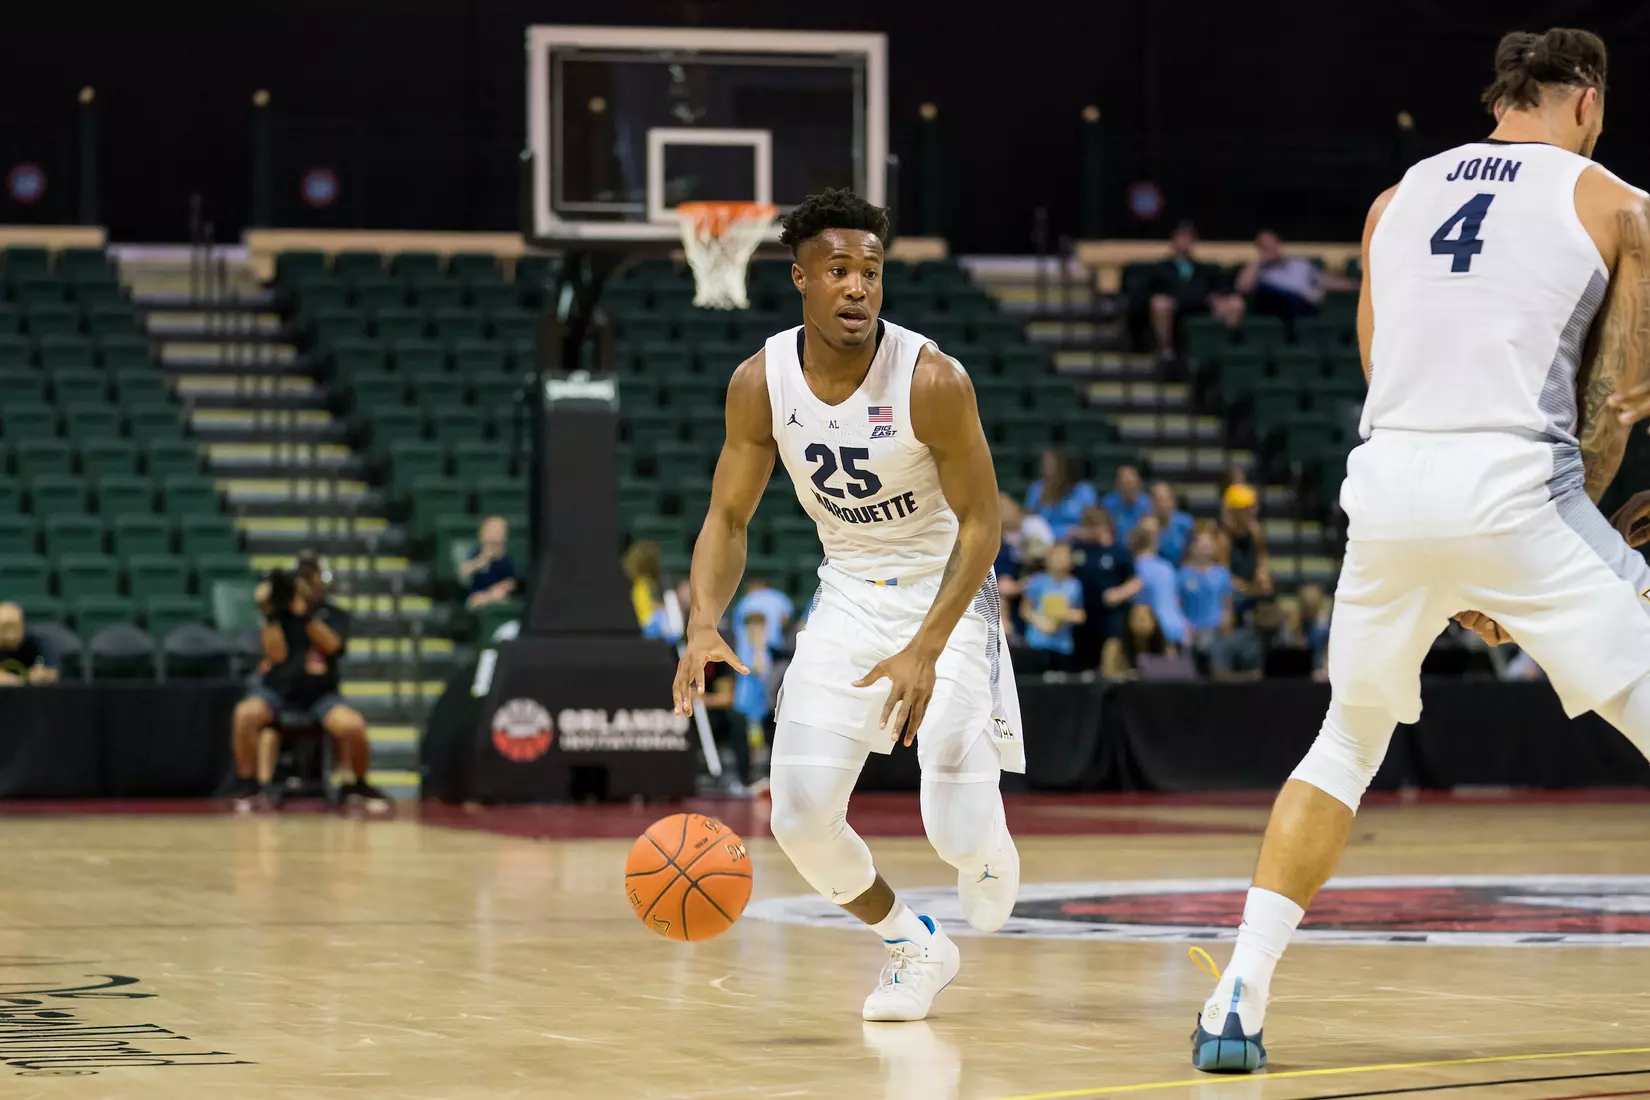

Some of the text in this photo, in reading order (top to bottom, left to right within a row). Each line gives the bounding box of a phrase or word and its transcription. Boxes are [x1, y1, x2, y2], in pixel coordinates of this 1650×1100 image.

[1446, 156, 1522, 182] JOHN
[1430, 193, 1496, 272] 4
[828, 420, 840, 429] AL
[805, 443, 882, 499] 25
